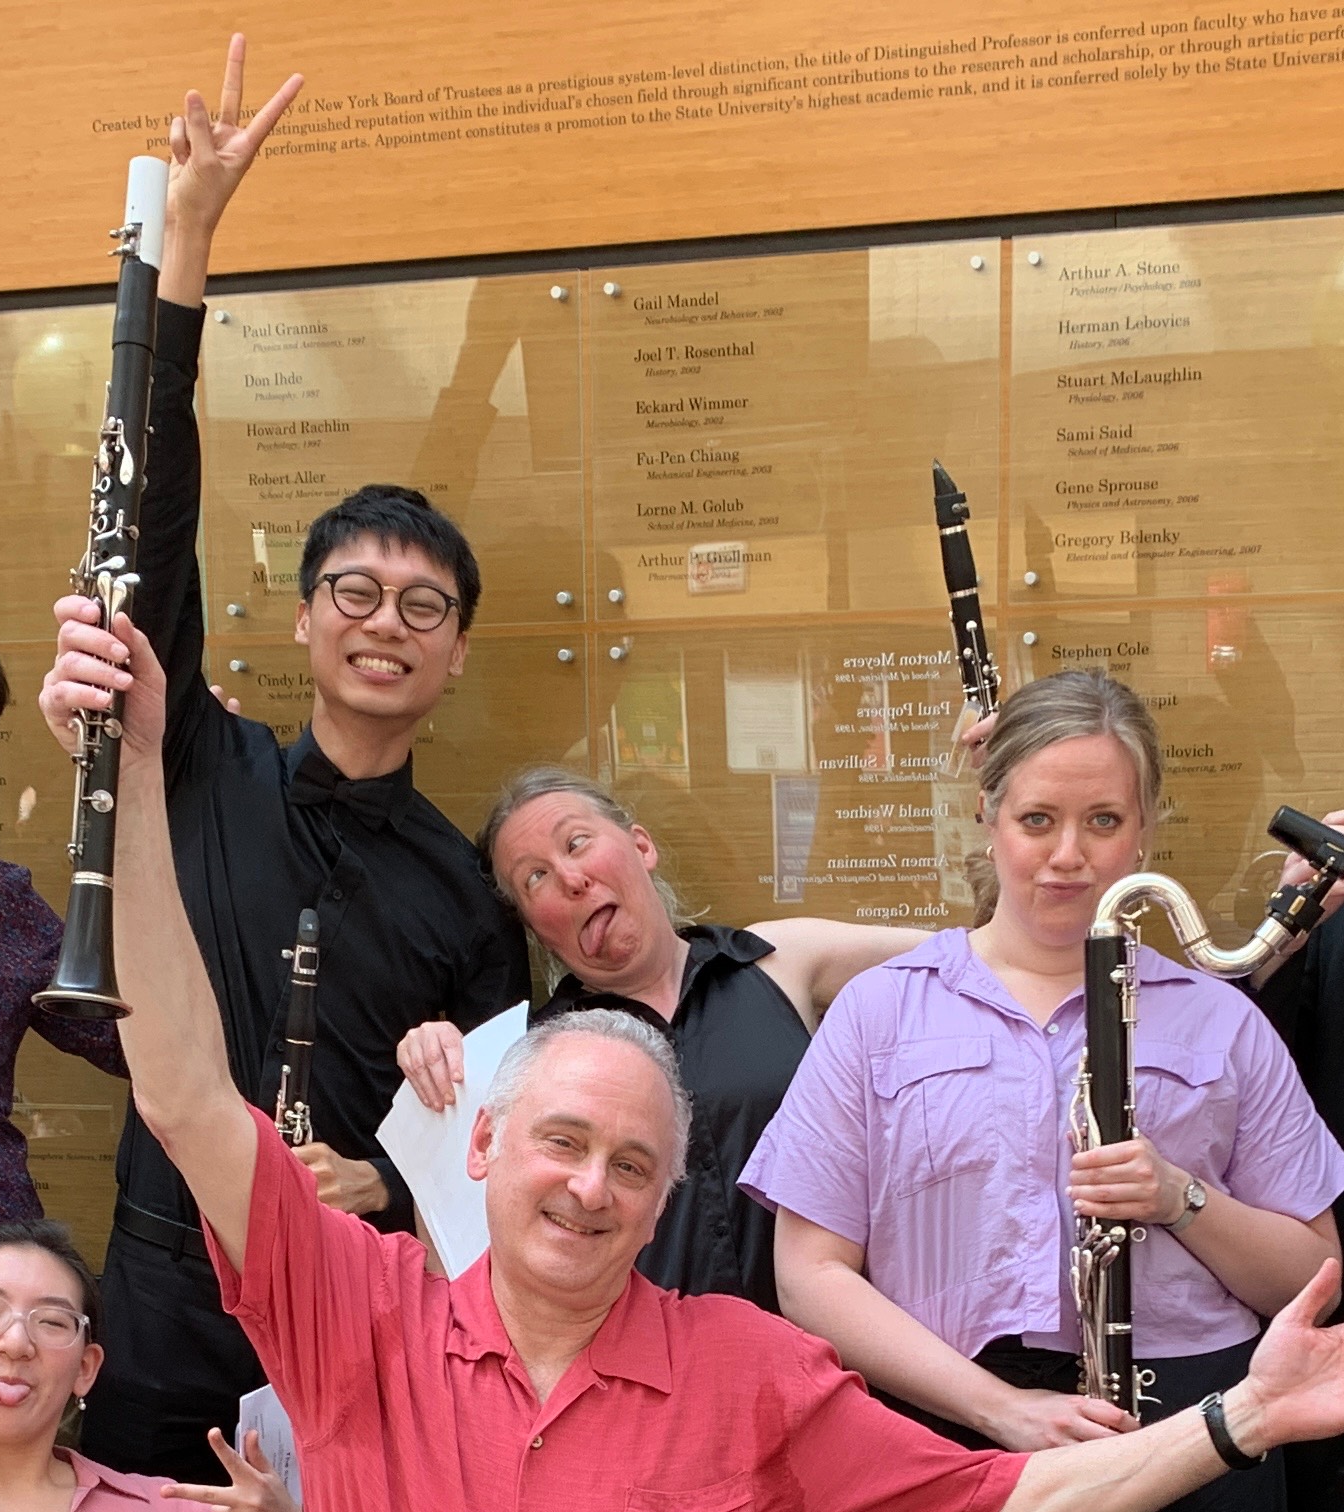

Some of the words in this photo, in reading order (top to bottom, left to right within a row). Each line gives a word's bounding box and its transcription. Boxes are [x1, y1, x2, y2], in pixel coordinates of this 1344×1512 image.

[92, 115, 141, 133] Created
[145, 115, 160, 130] by
[297, 101, 310, 113] of
[315, 98, 343, 112] New
[347, 94, 379, 109] York
[384, 90, 423, 106] Board
[427, 87, 440, 102] of
[443, 86, 502, 100] Trustees
[507, 85, 521, 95] as
[526, 84, 533, 93] a
[539, 75, 614, 94] prestigious
[619, 63, 704, 86] system-level
[709, 60, 789, 75] distinction,
[794, 54, 817, 68] the
[822, 51, 851, 65] title
[856, 48, 870, 62] of
[875, 38, 976, 60] Distinguished
[982, 35, 1051, 51] Professor
[1057, 34, 1069, 44] is
[1073, 23, 1145, 42] conferred
[1151, 22, 1188, 37] upon
[1194, 15, 1246, 31] faculty
[1253, 10, 1284, 26] who
[1290, 8, 1327, 22] have
[355, 113, 424, 130] reputation
[429, 106, 472, 121] within
[477, 104, 498, 117] the
[503, 95, 582, 115] individual's
[586, 94, 633, 107] chosen
[638, 86, 668, 103] field
[673, 82, 728, 99] through
[734, 76, 807, 96] significant
[813, 67, 909, 87] contributions
[915, 66, 928, 78] to
[933, 61, 956, 76] the
[962, 55, 1024, 74] research
[1030, 50, 1058, 68] and
[1063, 43, 1154, 65] scholarship,
[1159, 45, 1175, 55] or
[1181, 35, 1241, 54] through
[1248, 32, 1304, 48] artistic
[264, 139, 337, 159] performing
[341, 138, 370, 150] arts.
[375, 128, 461, 149] Appointment
[466, 123, 540, 139] constitutes
[545, 121, 552, 132] a
[557, 116, 626, 134] promotion
[631, 113, 645, 124] to
[649, 108, 671, 122] the
[676, 106, 713, 120] State
[718, 96, 803, 116] University's
[808, 92, 861, 109] highest
[866, 87, 933, 103] academic
[938, 80, 977, 97] rank,
[982, 77, 1009, 93] and
[1015, 76, 1025, 90] it
[1031, 74, 1043, 88] is
[1048, 67, 1119, 88] conferred
[1124, 63, 1167, 82] solely
[1173, 61, 1190, 79] by
[1196, 59, 1220, 74] the
[1225, 57, 1267, 72] State
[634, 296, 662, 311] Gail
[668, 291, 718, 307] Mandel
[243, 323, 271, 338] Paul
[275, 323, 328, 336] Grannis
[634, 348, 661, 362] Joel
[685, 341, 754, 359] Rosenthal
[1057, 375, 1105, 388] Stuart
[1111, 368, 1202, 386] McLaughlin
[636, 398, 684, 414] Eckard
[689, 397, 748, 411] Wimmer
[247, 421, 296, 437] Howard
[301, 419, 350, 433] Rachlin
[1057, 427, 1094, 442] Sami
[1099, 424, 1132, 440] Said
[249, 473, 290, 486] Robert
[294, 471, 325, 484] Aller
[1056, 481, 1093, 495] Gene
[1098, 479, 1158, 495] Sprouse
[637, 503, 676, 517] Lorne
[703, 498, 743, 513] Golub
[1054, 534, 1114, 551] Gregory
[1121, 528, 1180, 546] Belenky
[1052, 644, 1112, 660] Stephen
[1117, 641, 1149, 657] Cole
